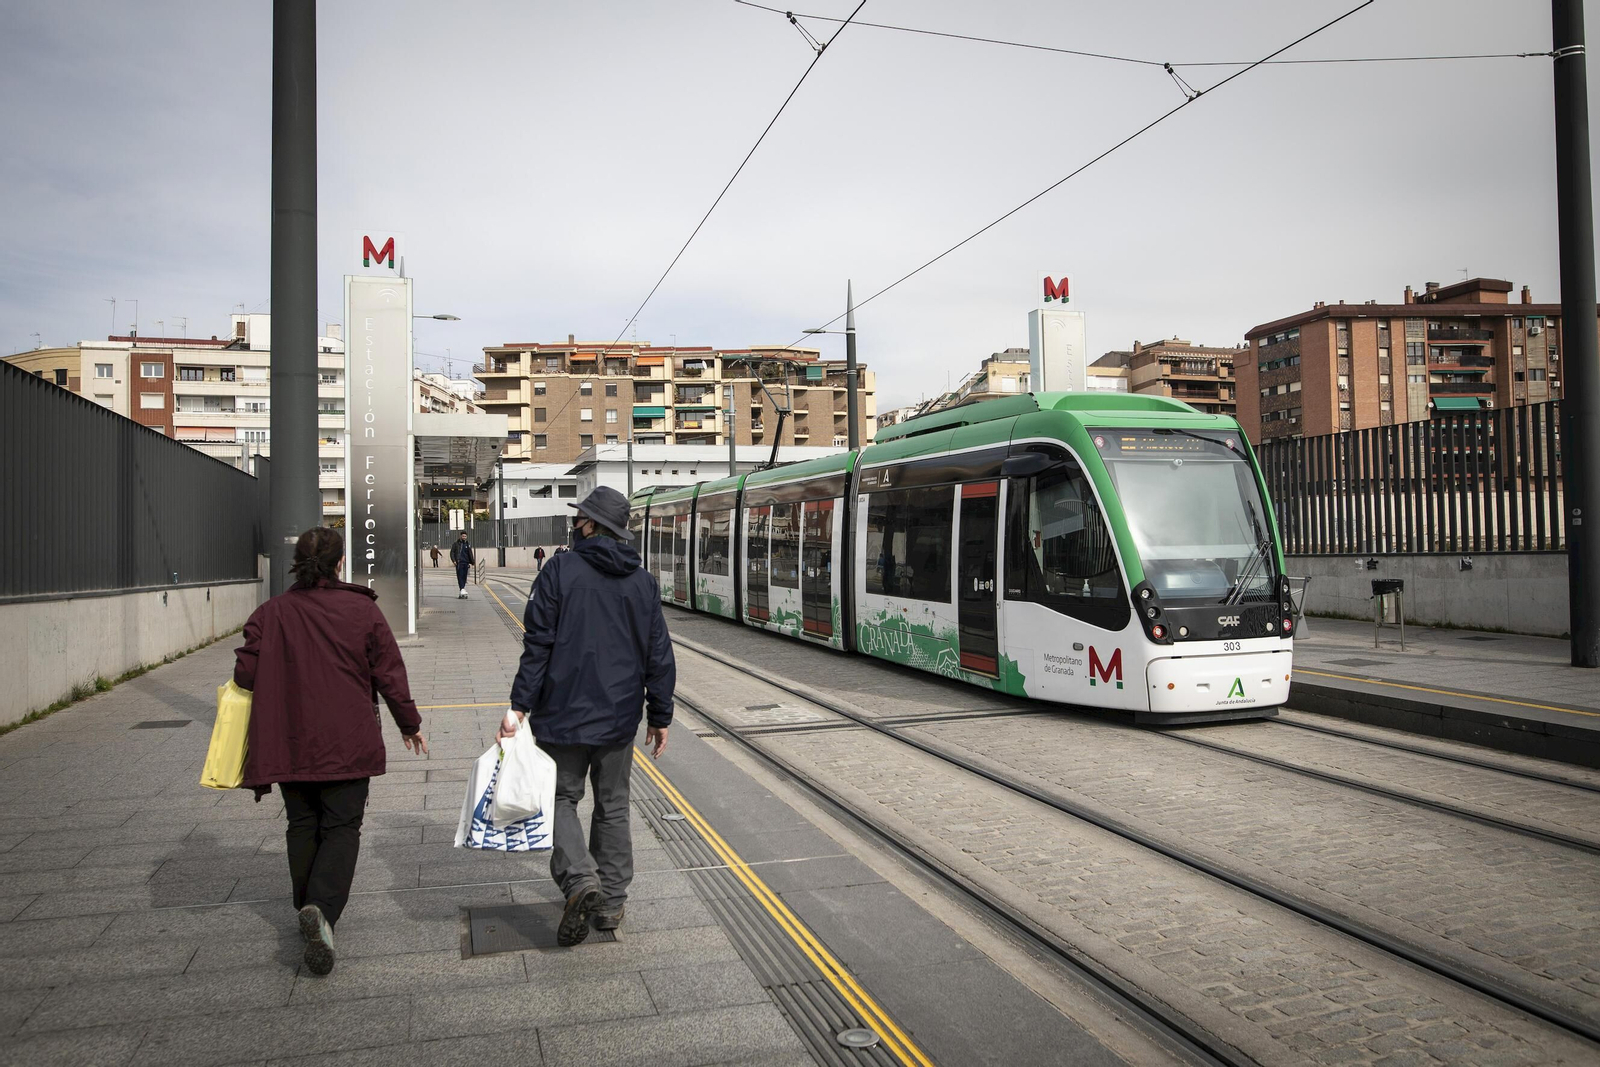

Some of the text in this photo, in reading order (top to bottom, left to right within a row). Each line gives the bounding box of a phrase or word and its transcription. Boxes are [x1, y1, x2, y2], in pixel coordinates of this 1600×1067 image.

[363, 235, 394, 268] M
[1044, 276, 1069, 303] M
[364, 317, 376, 588] Estación Ferrocarr
[1217, 615, 1240, 627] CAF
[1223, 641, 1241, 651] 303
[1043, 653, 1083, 666] Metropolitano
[1088, 645, 1124, 689] M
[1044, 664, 1075, 676] de Granada
